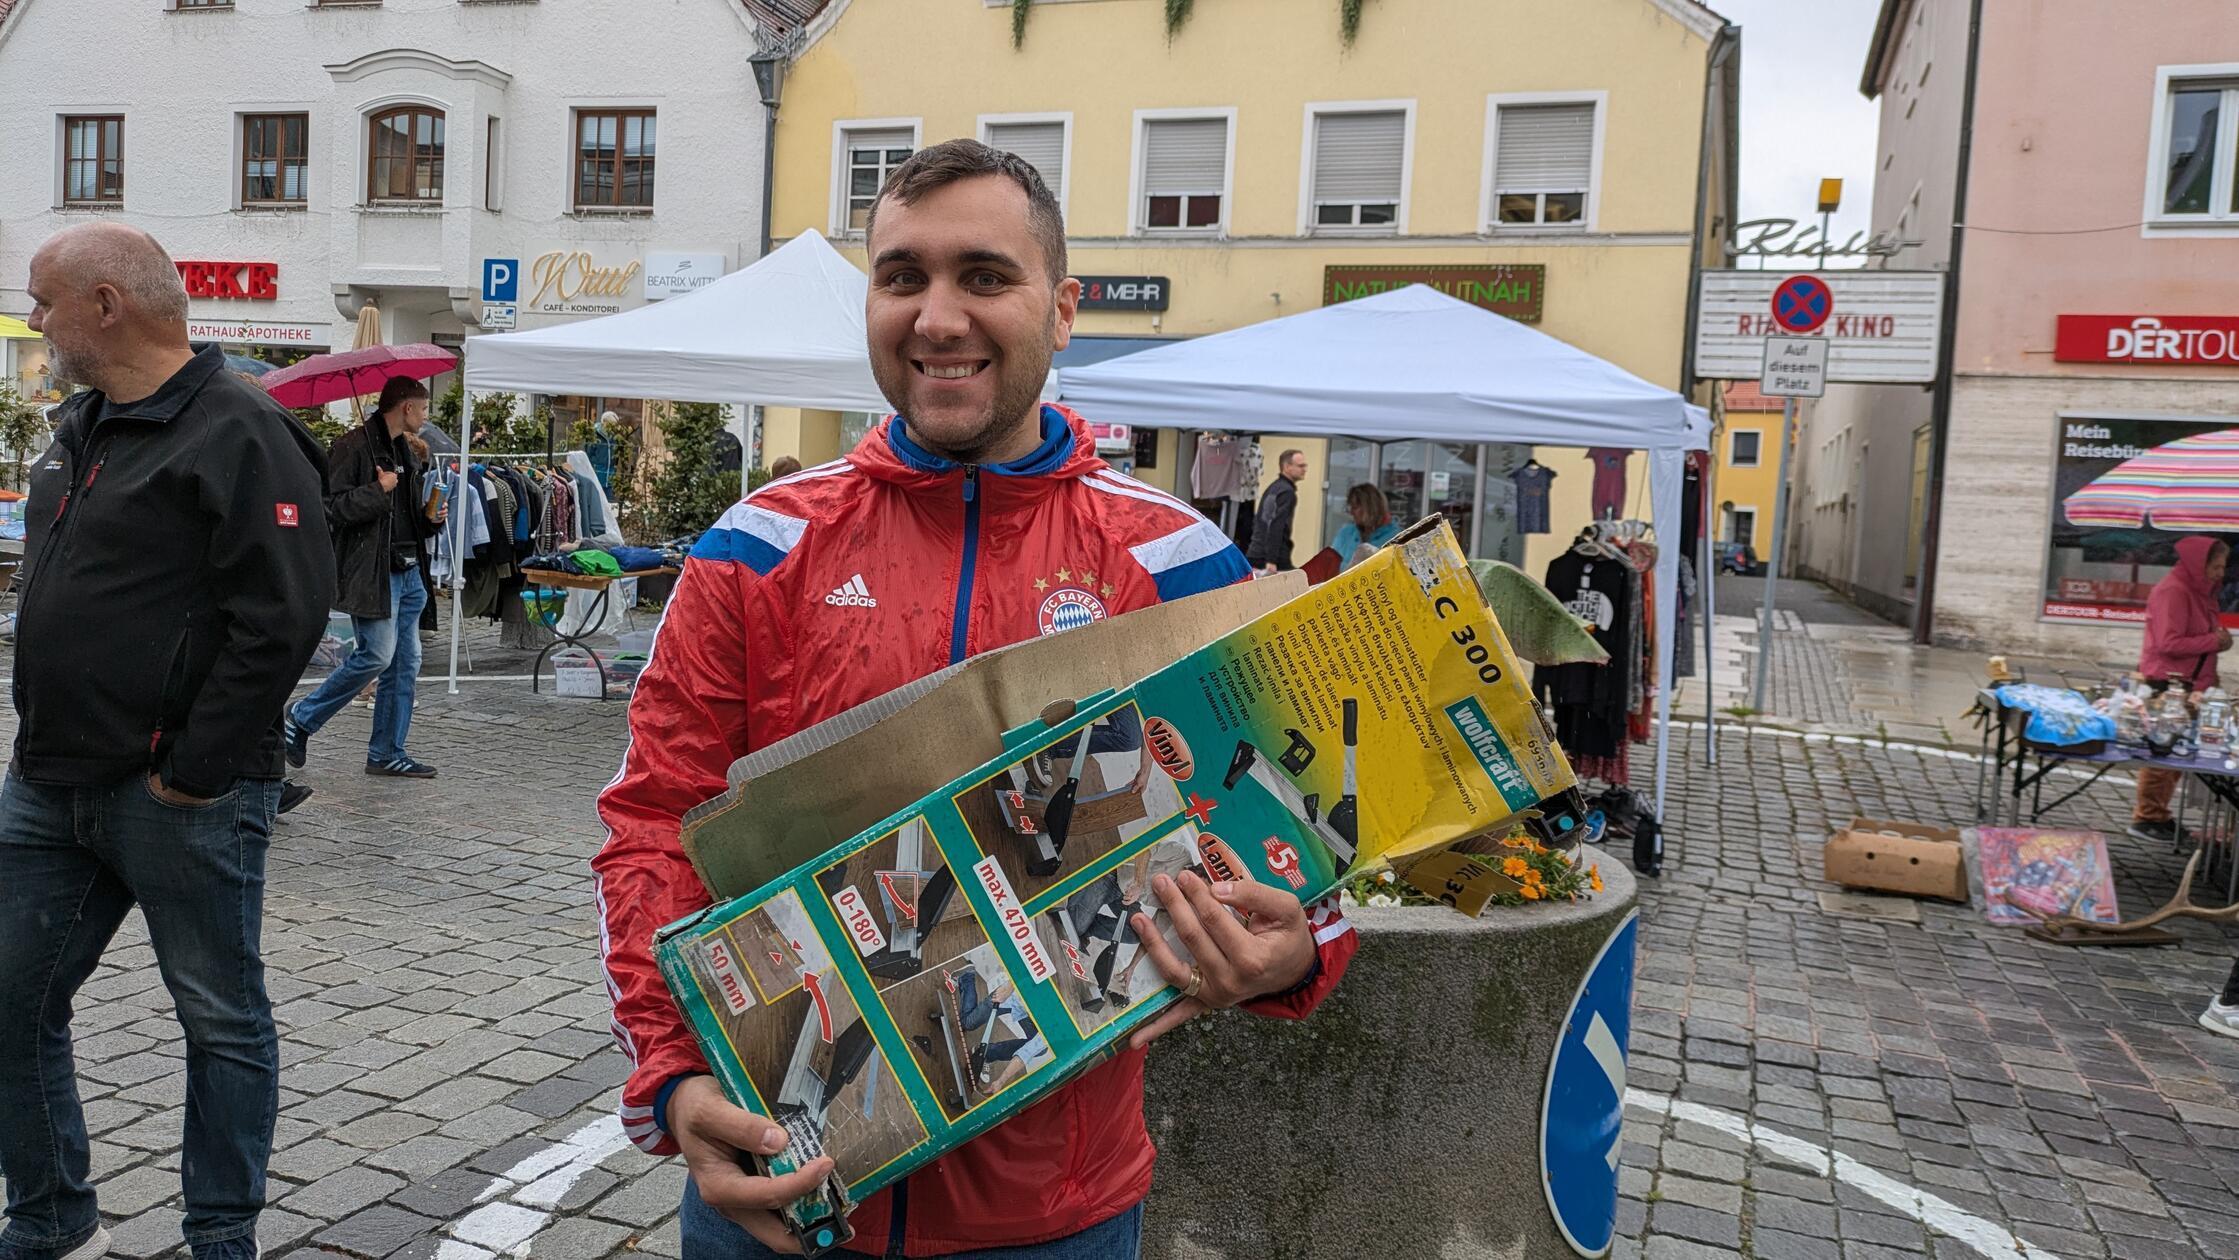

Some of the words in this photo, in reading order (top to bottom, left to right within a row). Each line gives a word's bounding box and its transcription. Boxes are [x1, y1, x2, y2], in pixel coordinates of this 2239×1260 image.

[175, 261, 278, 299] EKE
[490, 263, 510, 297] P
[647, 275, 686, 287] BEATRIX
[688, 276, 716, 287] WITT
[1088, 283, 1103, 300] &
[1106, 283, 1160, 301] MEHR
[543, 303, 564, 312] CAFÉ
[570, 304, 620, 313] KONDITOREI
[1835, 314, 1895, 338] KINO
[190, 325, 245, 338] RATHAUS
[249, 327, 312, 341] APOTHEKE
[1784, 344, 1809, 357] Auf
[1768, 362, 1820, 374] diesem
[1775, 377, 1811, 391] Platz
[2065, 424, 2112, 440] Mein
[825, 594, 877, 608] adidas
[1044, 599, 1058, 615] FC
[1058, 592, 1104, 620] BAYERN
[1297, 623, 1321, 667] Dispozitiv
[1318, 669, 1328, 681] de
[1306, 617, 1330, 656] parketta
[1342, 599, 1358, 621] Vinil
[1352, 622, 1361, 634] ve
[1358, 634, 1379, 670] laminat
[1374, 669, 1393, 702] kesicisi
[1376, 582, 1393, 606] Vinyl
[1387, 607, 1397, 621] og
[1394, 620, 1427, 681] laminatkutter
[1242, 651, 1264, 692] laminata
[1253, 646, 1271, 674] Rezač
[1266, 674, 1281, 699] vinila
[1275, 634, 1297, 675] Резачка
[1294, 676, 1303, 688] за
[1348, 643, 1365, 672] vinylu
[1451, 625, 1501, 683] 300
[1230, 657, 1255, 704] Режущее
[1264, 641, 1285, 677] панели
[1281, 678, 1289, 686] и
[1285, 687, 1310, 728] ламинат
[1286, 629, 1301, 649] vinil
[1298, 659, 1320, 694] parchet
[1316, 693, 1337, 729] laminat
[1365, 588, 1385, 626] Gilotyna
[1382, 627, 1392, 639] do
[1398, 665, 1418, 692] paneli
[1414, 693, 1443, 745] winylowych
[1441, 750, 1476, 814] laminowanych
[1148, 721, 1191, 774] Vinyl
[1455, 706, 1524, 790] wolfcraft
[1200, 839, 1243, 882] Lami
[1267, 846, 1297, 869] 5
[839, 892, 880, 945] 0-180°
[979, 863, 1006, 907] max.
[1005, 908, 1029, 939] 470
[1021, 941, 1046, 976] mm
[707, 944, 728, 969] 50
[718, 972, 745, 1008] mm
